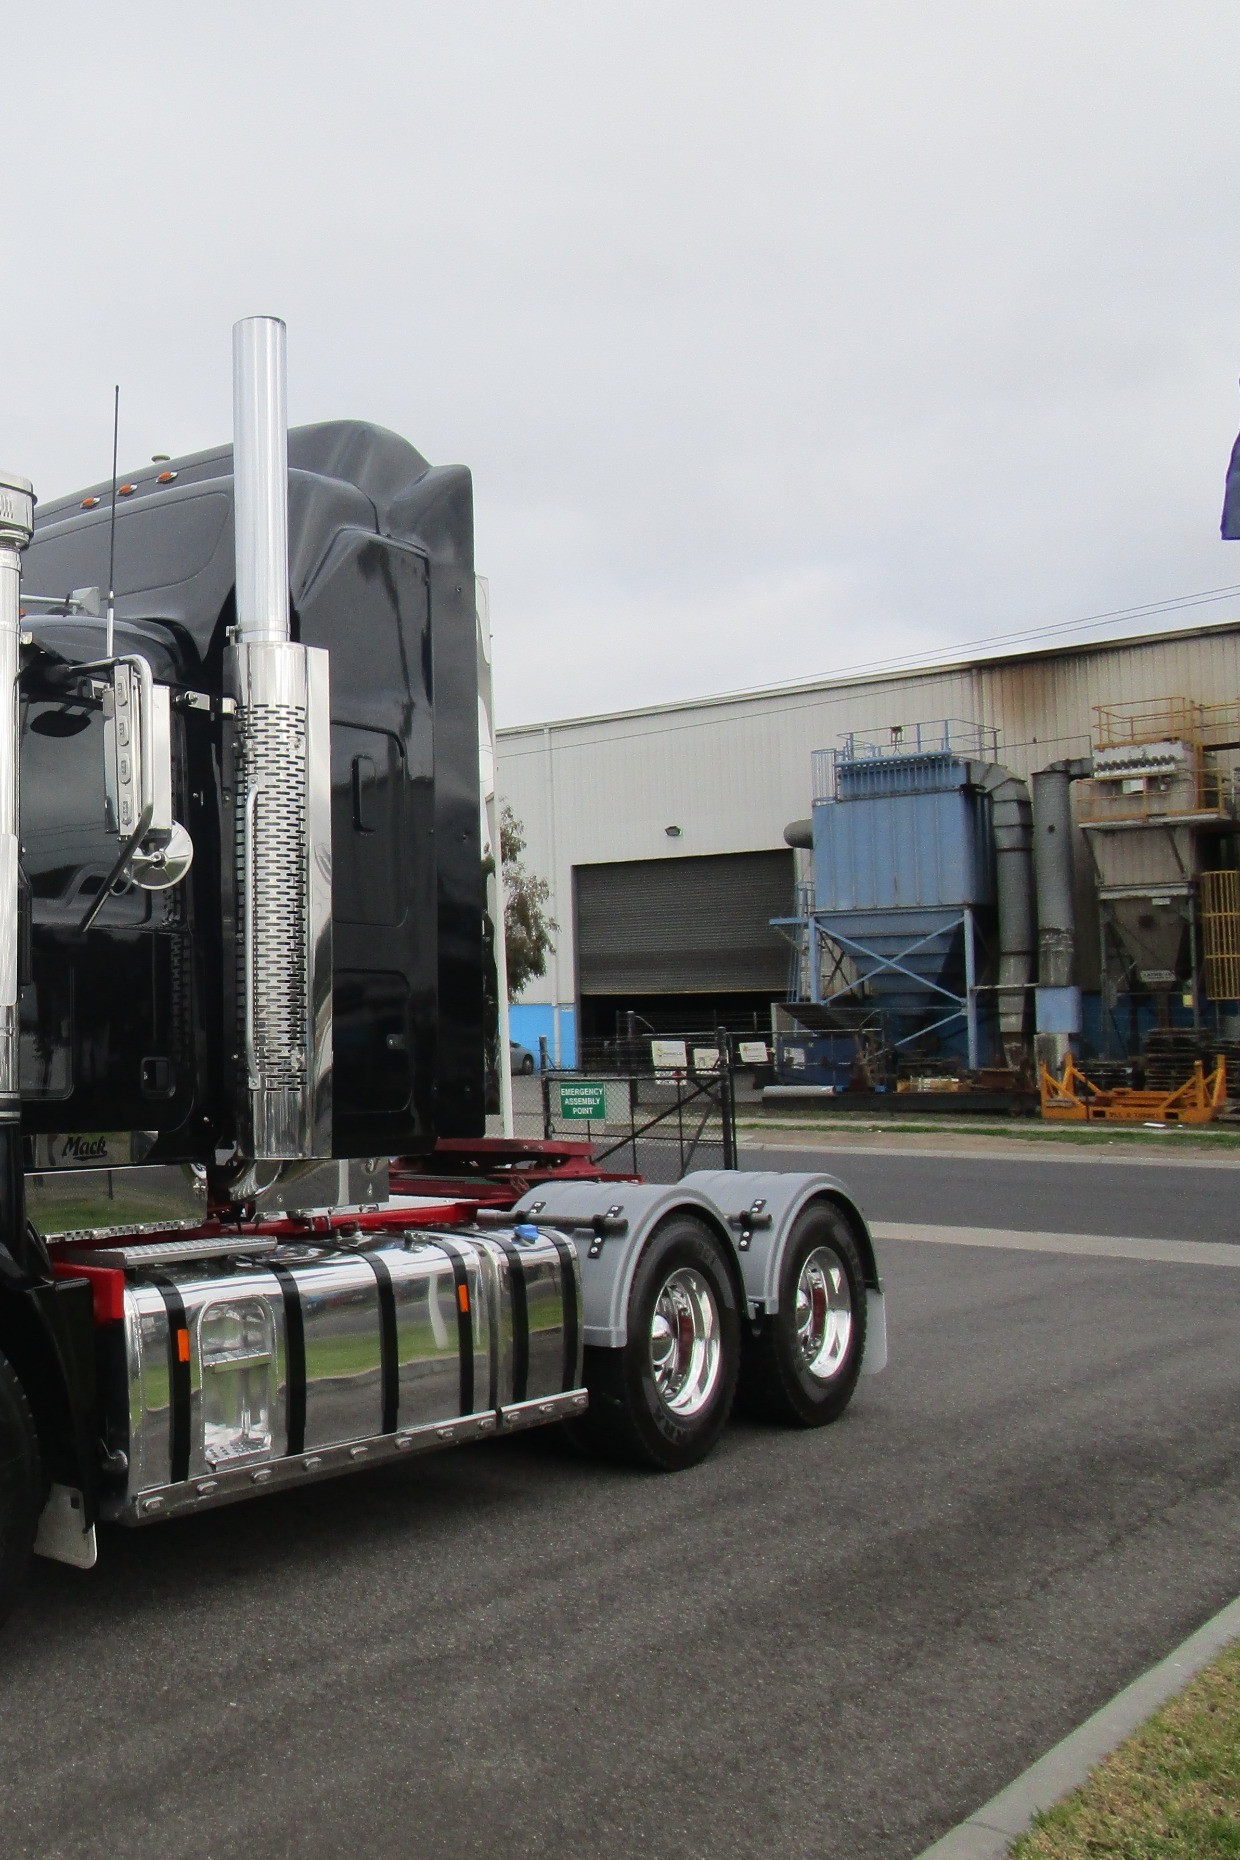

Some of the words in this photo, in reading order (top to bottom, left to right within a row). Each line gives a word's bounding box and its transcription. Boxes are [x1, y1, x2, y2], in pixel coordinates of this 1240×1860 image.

[560, 1087, 604, 1096] EMERGENCY
[564, 1097, 601, 1105] ASSEMBLY
[572, 1107, 594, 1115] POINT
[61, 1135, 108, 1160] Mack
